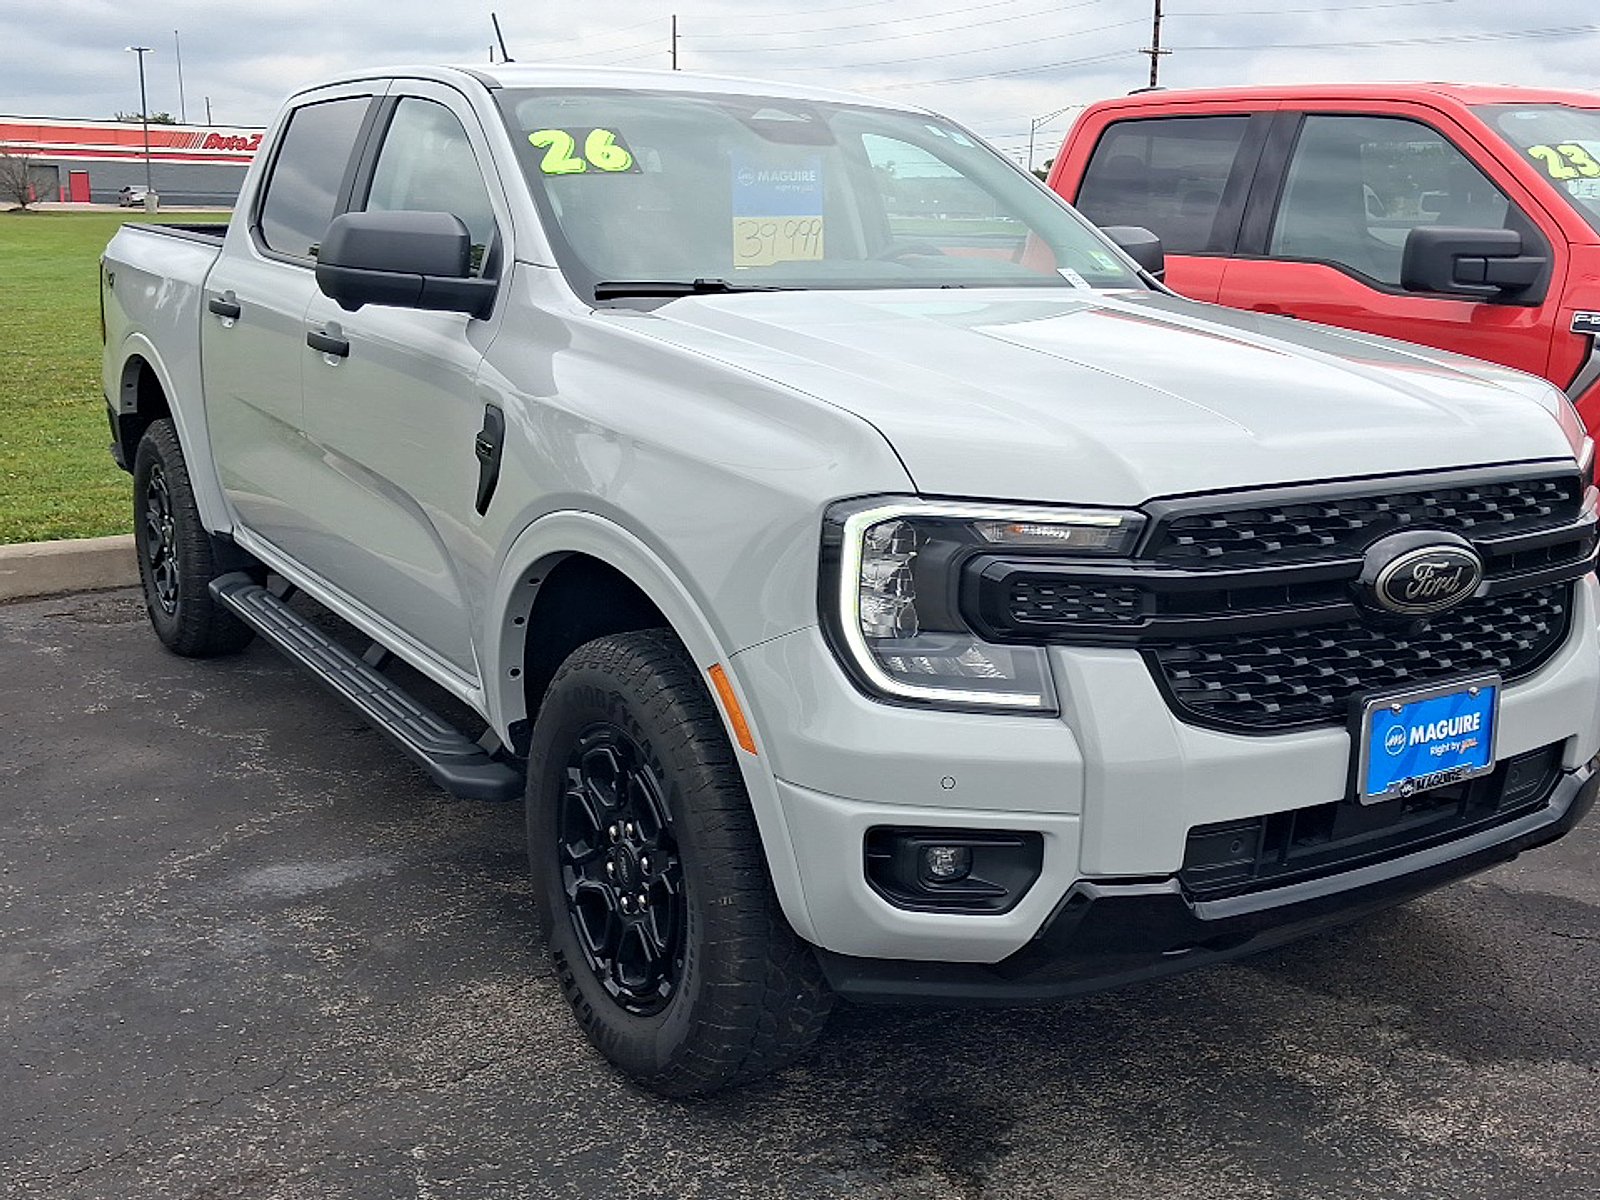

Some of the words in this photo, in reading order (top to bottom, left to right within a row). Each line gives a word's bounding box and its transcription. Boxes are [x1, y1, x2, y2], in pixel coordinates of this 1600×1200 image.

[528, 128, 632, 175] 26
[1527, 144, 1600, 179] 23
[758, 169, 816, 182] MAGUIRE
[1405, 561, 1463, 600] Ford
[1409, 711, 1480, 747] MAGUIRE
[1430, 743, 1450, 757] Right
[1450, 740, 1461, 753] by
